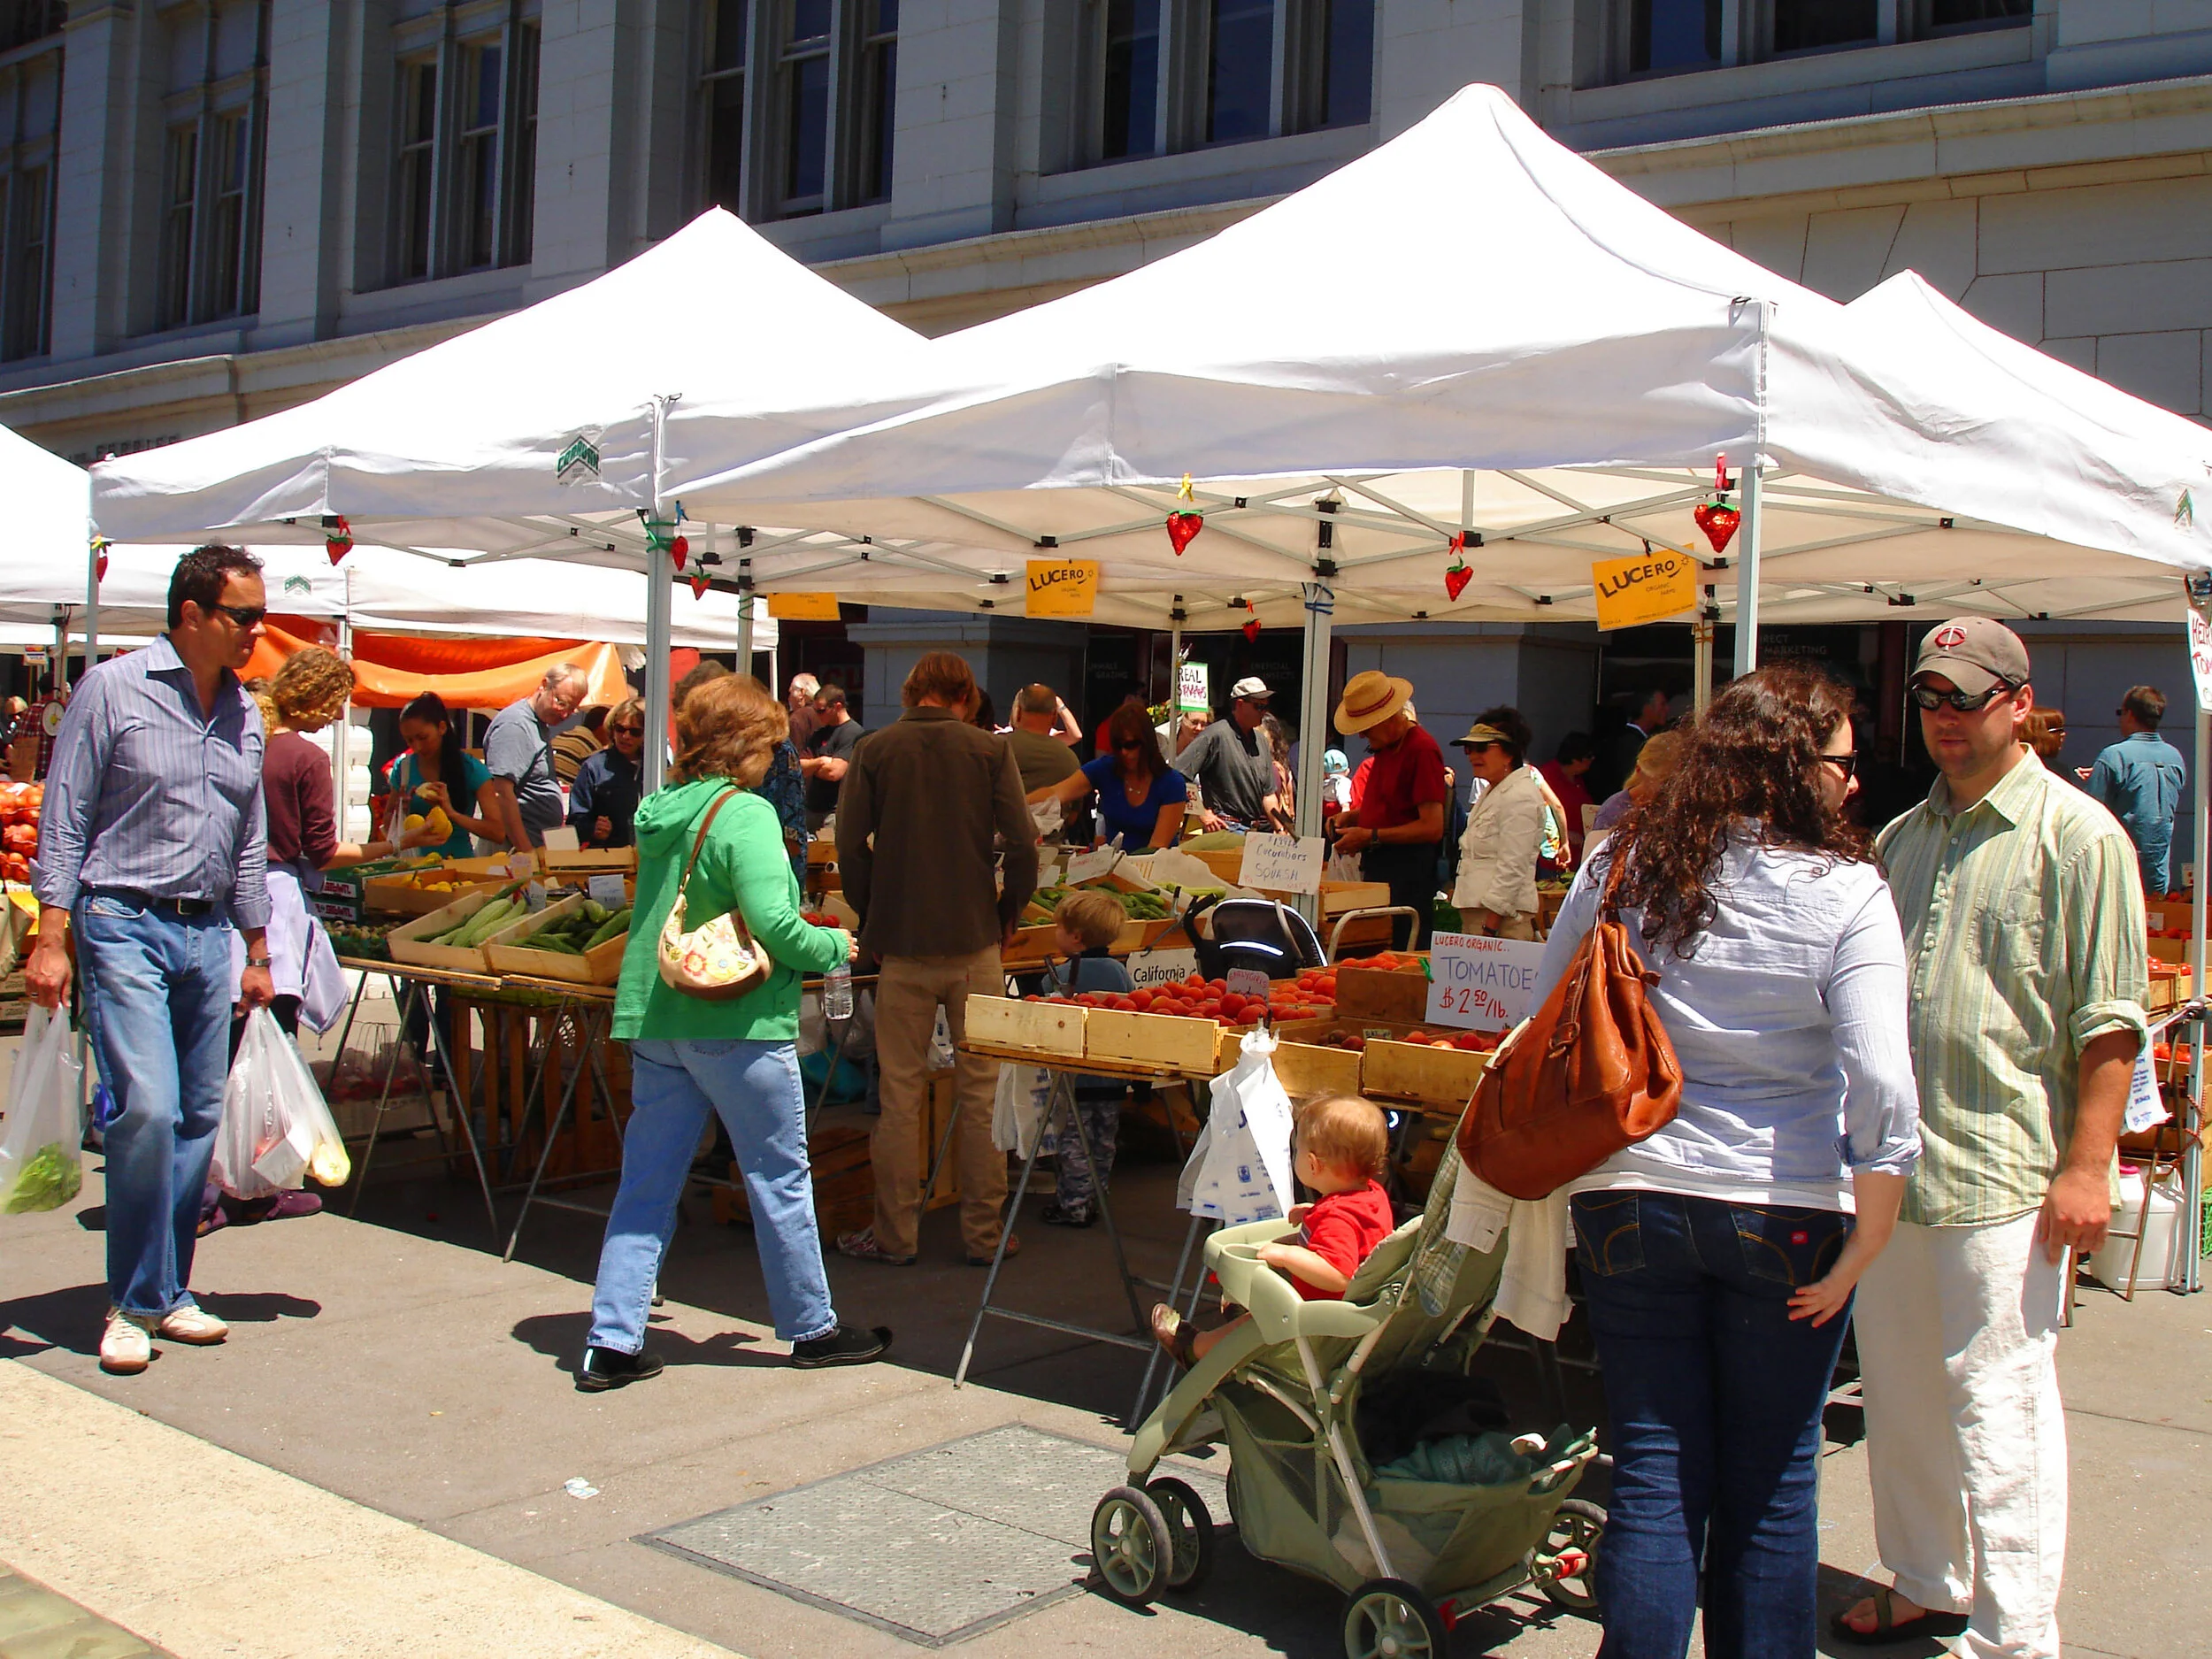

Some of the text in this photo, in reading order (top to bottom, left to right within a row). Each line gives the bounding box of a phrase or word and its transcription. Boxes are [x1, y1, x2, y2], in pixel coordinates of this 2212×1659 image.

[1030, 569, 1084, 592] LUCERO
[1598, 559, 1675, 599] LUCERO
[1177, 667, 1202, 684] REAL
[1434, 935, 1464, 948] LUCERO
[1133, 964, 1186, 983] California
